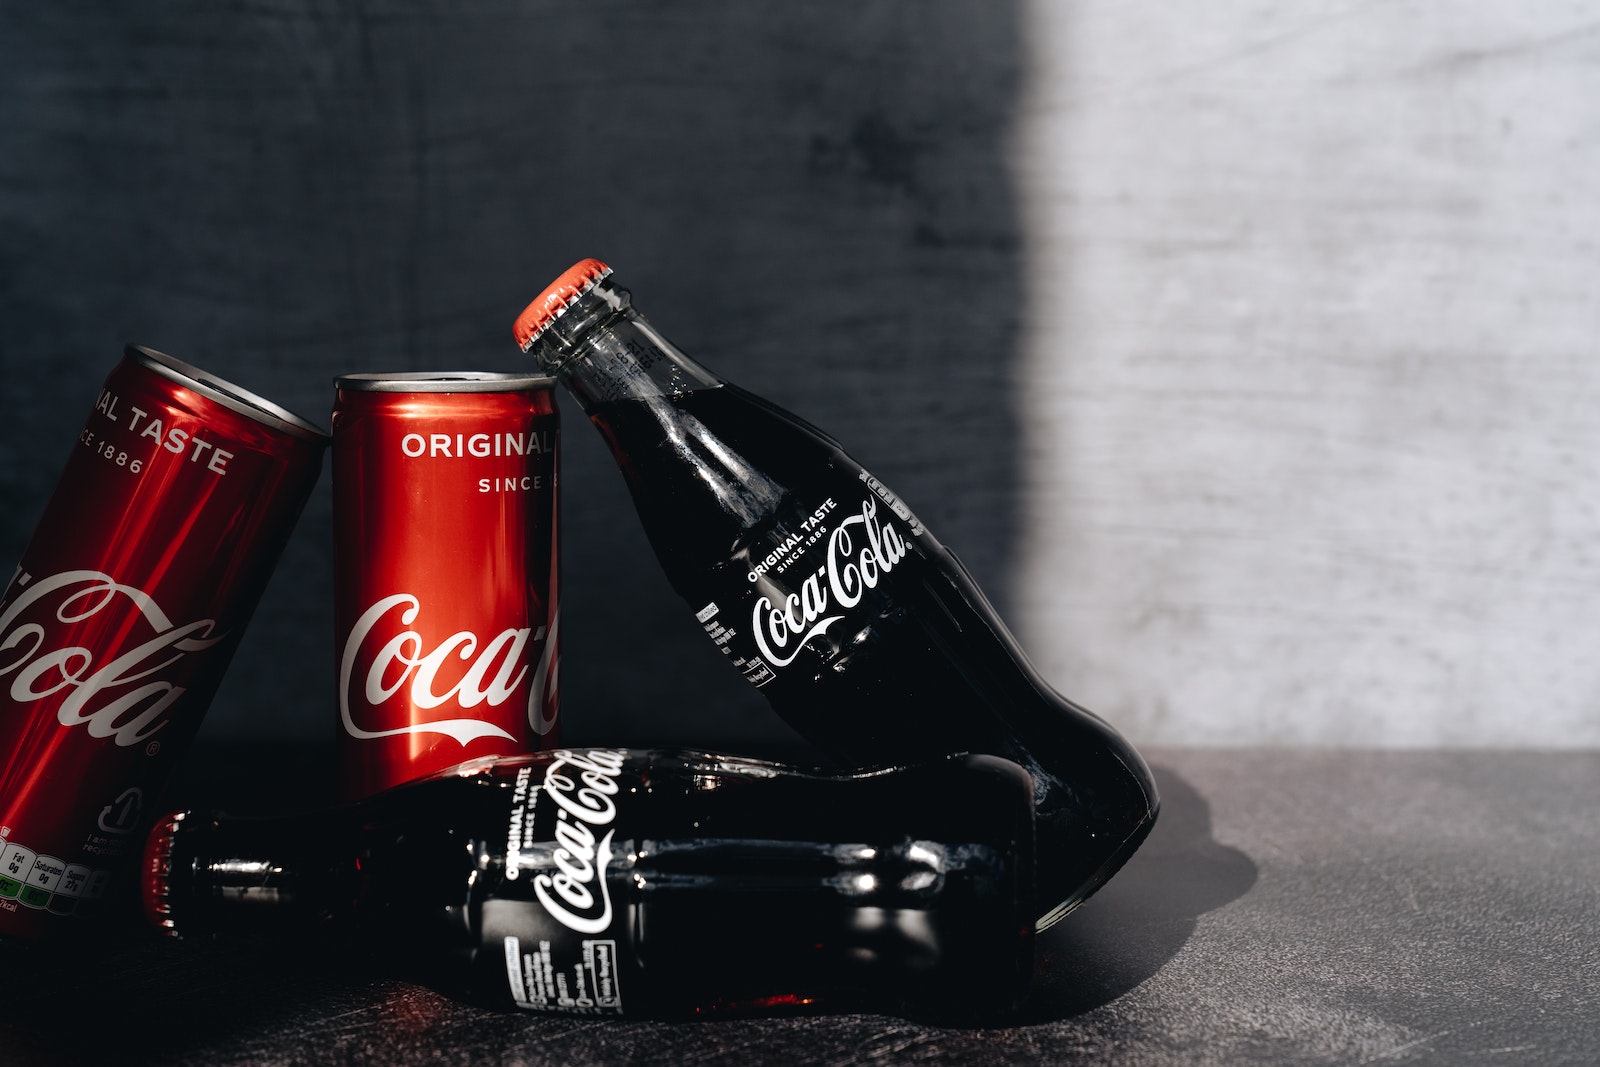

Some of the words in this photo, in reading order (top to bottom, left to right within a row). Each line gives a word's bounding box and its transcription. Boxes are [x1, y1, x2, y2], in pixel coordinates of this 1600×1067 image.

[129, 406, 234, 475] TASTE
[401, 431, 553, 458] ORIGINAL
[97, 440, 143, 474] 1886
[478, 475, 542, 493] SINCE
[747, 533, 804, 583] ORIGINAL
[801, 498, 838, 533] TASTE
[776, 546, 805, 574] SINCE
[805, 525, 828, 548] 1886
[512, 766, 532, 804] TASTE
[522, 811, 536, 848] SINCE
[8, 862, 20, 874] 0g
[12, 852, 25, 864] Fat
[34, 860, 63, 876] Saturates
[38, 873, 50, 885] 0g
